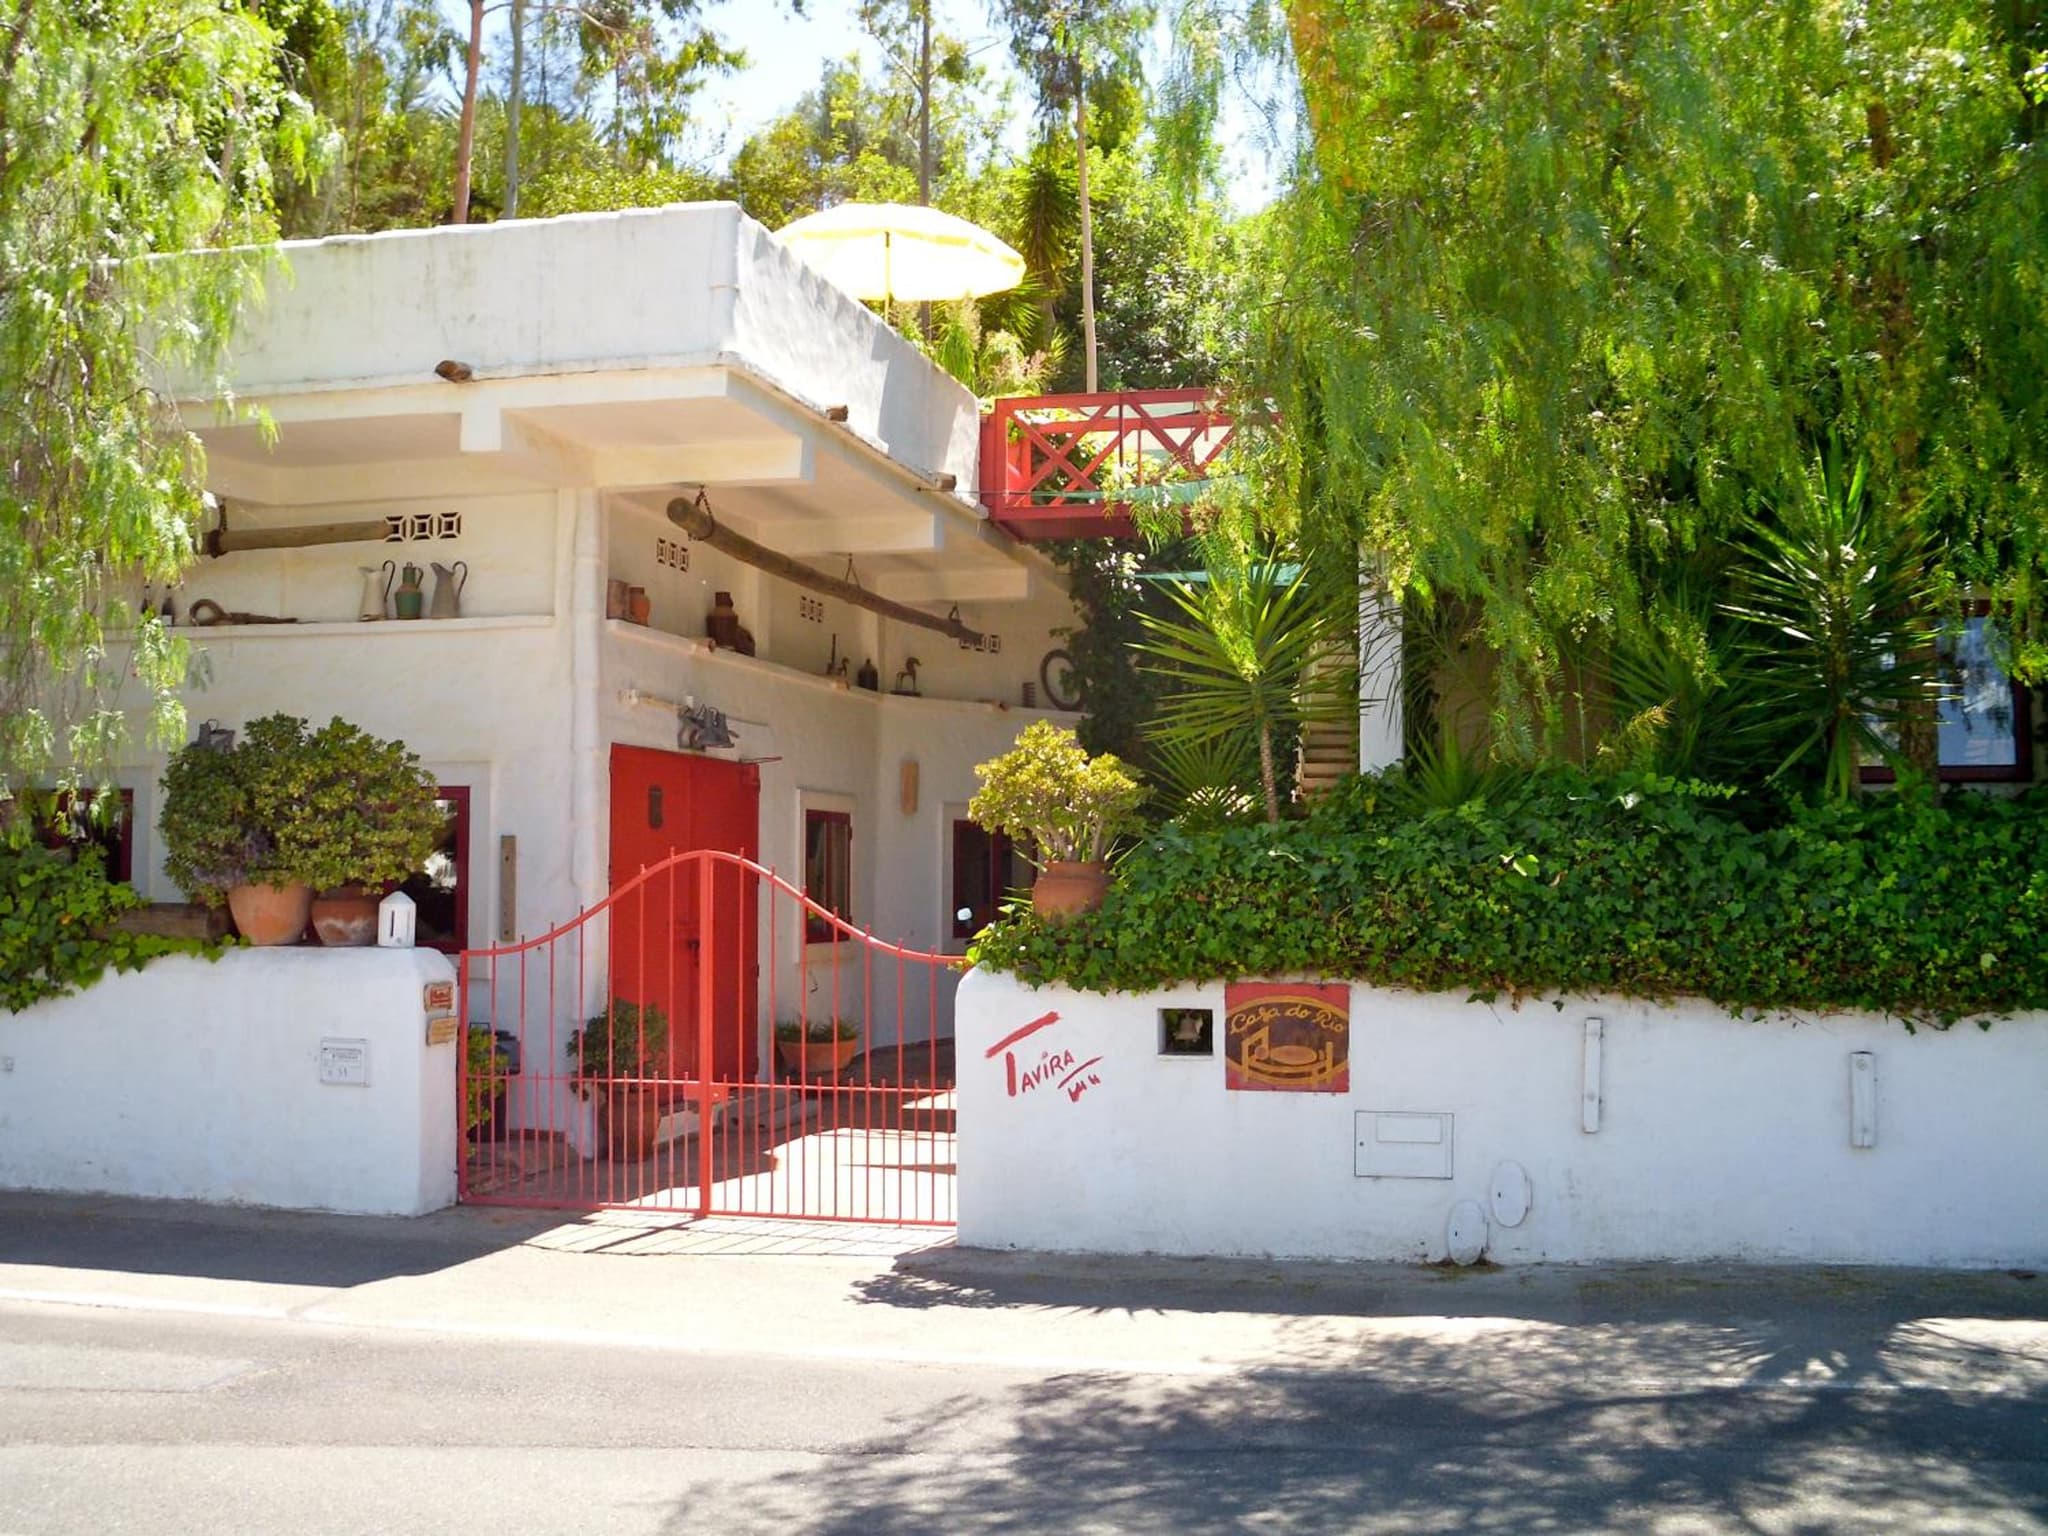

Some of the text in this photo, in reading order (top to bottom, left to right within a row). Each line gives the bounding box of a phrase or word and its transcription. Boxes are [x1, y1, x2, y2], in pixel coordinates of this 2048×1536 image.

[1230, 1005, 1345, 1034] Casa do Rio
